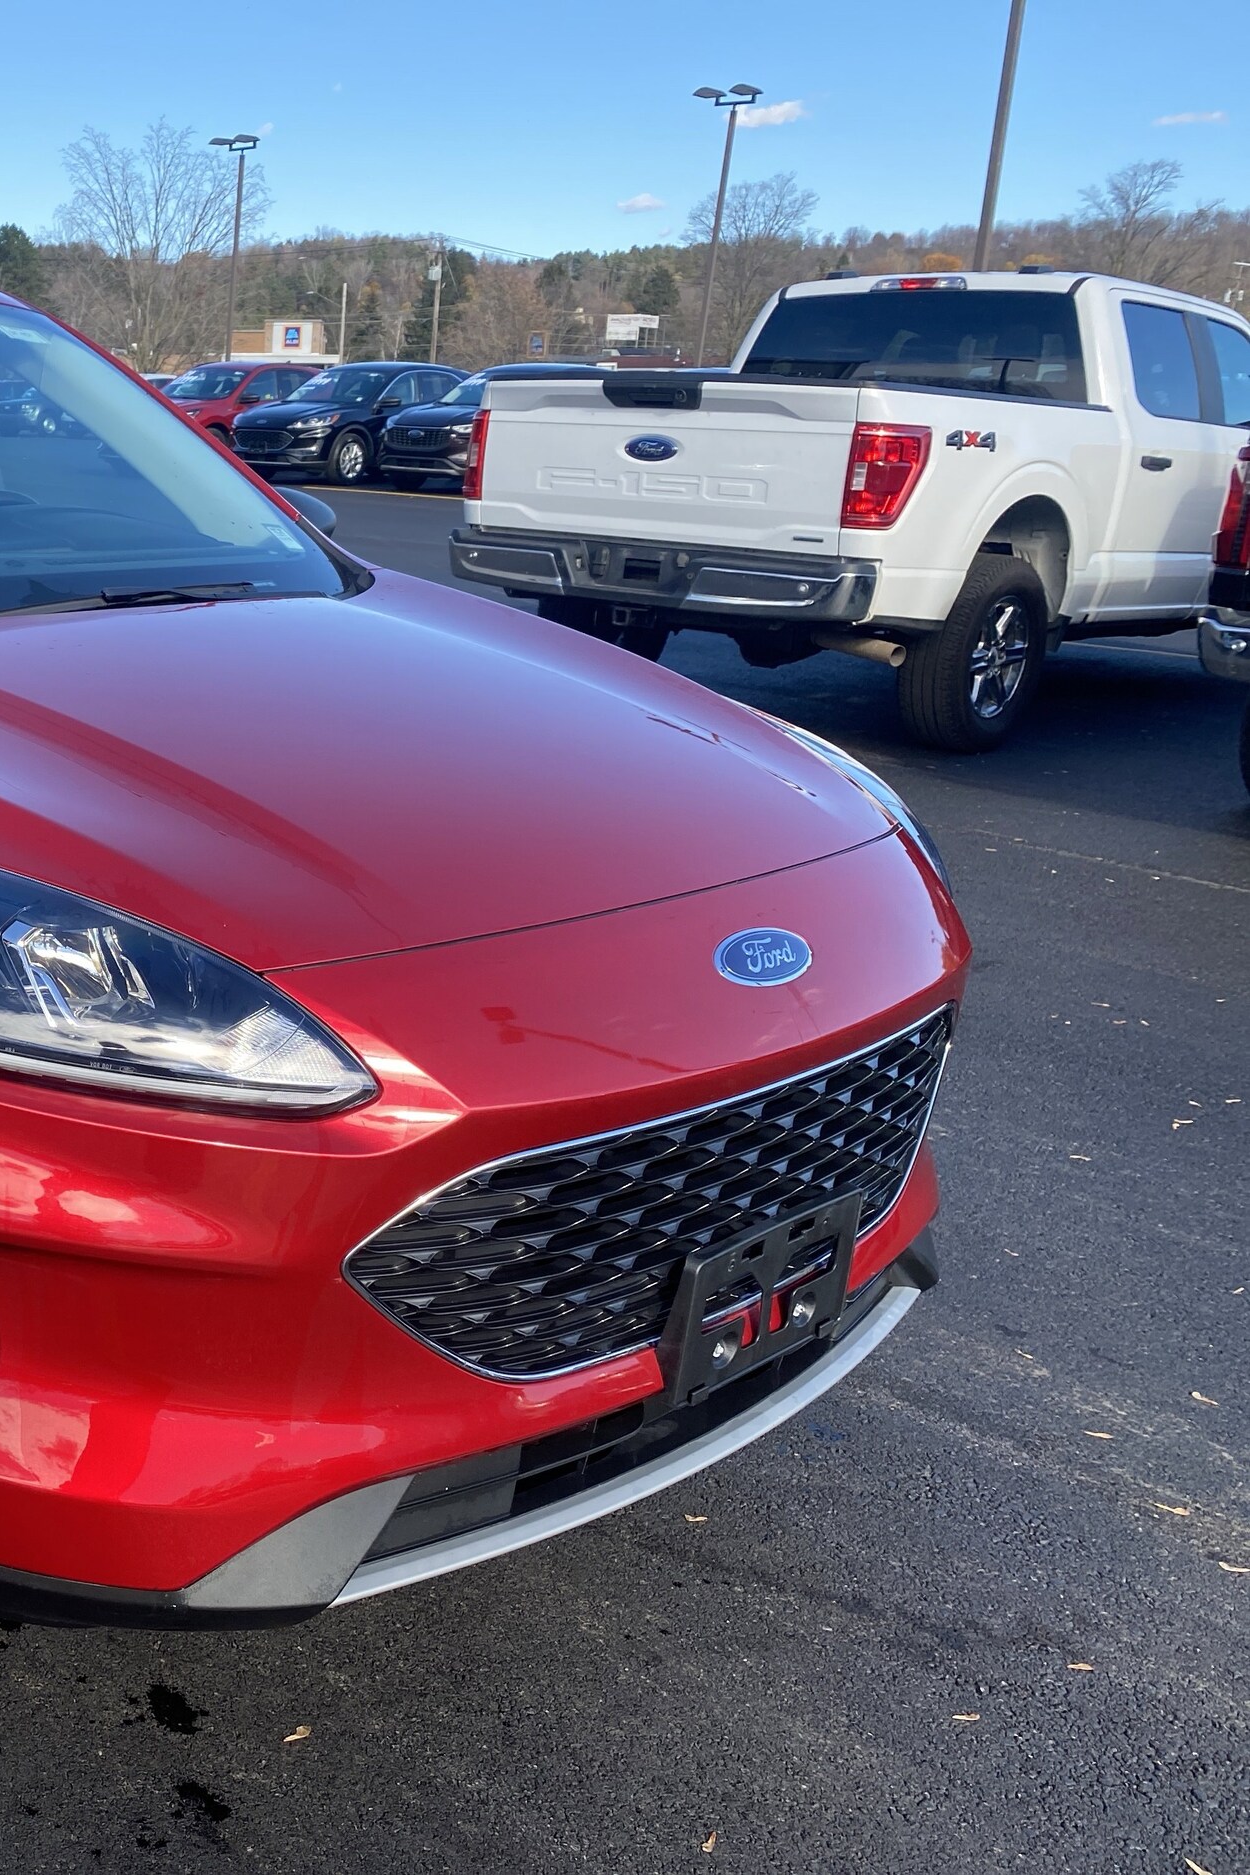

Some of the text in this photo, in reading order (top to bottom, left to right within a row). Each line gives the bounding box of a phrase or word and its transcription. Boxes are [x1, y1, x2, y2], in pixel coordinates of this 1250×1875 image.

[635, 440, 666, 457] Ford
[535, 465, 769, 505] F-150
[741, 936, 797, 974] Ford
